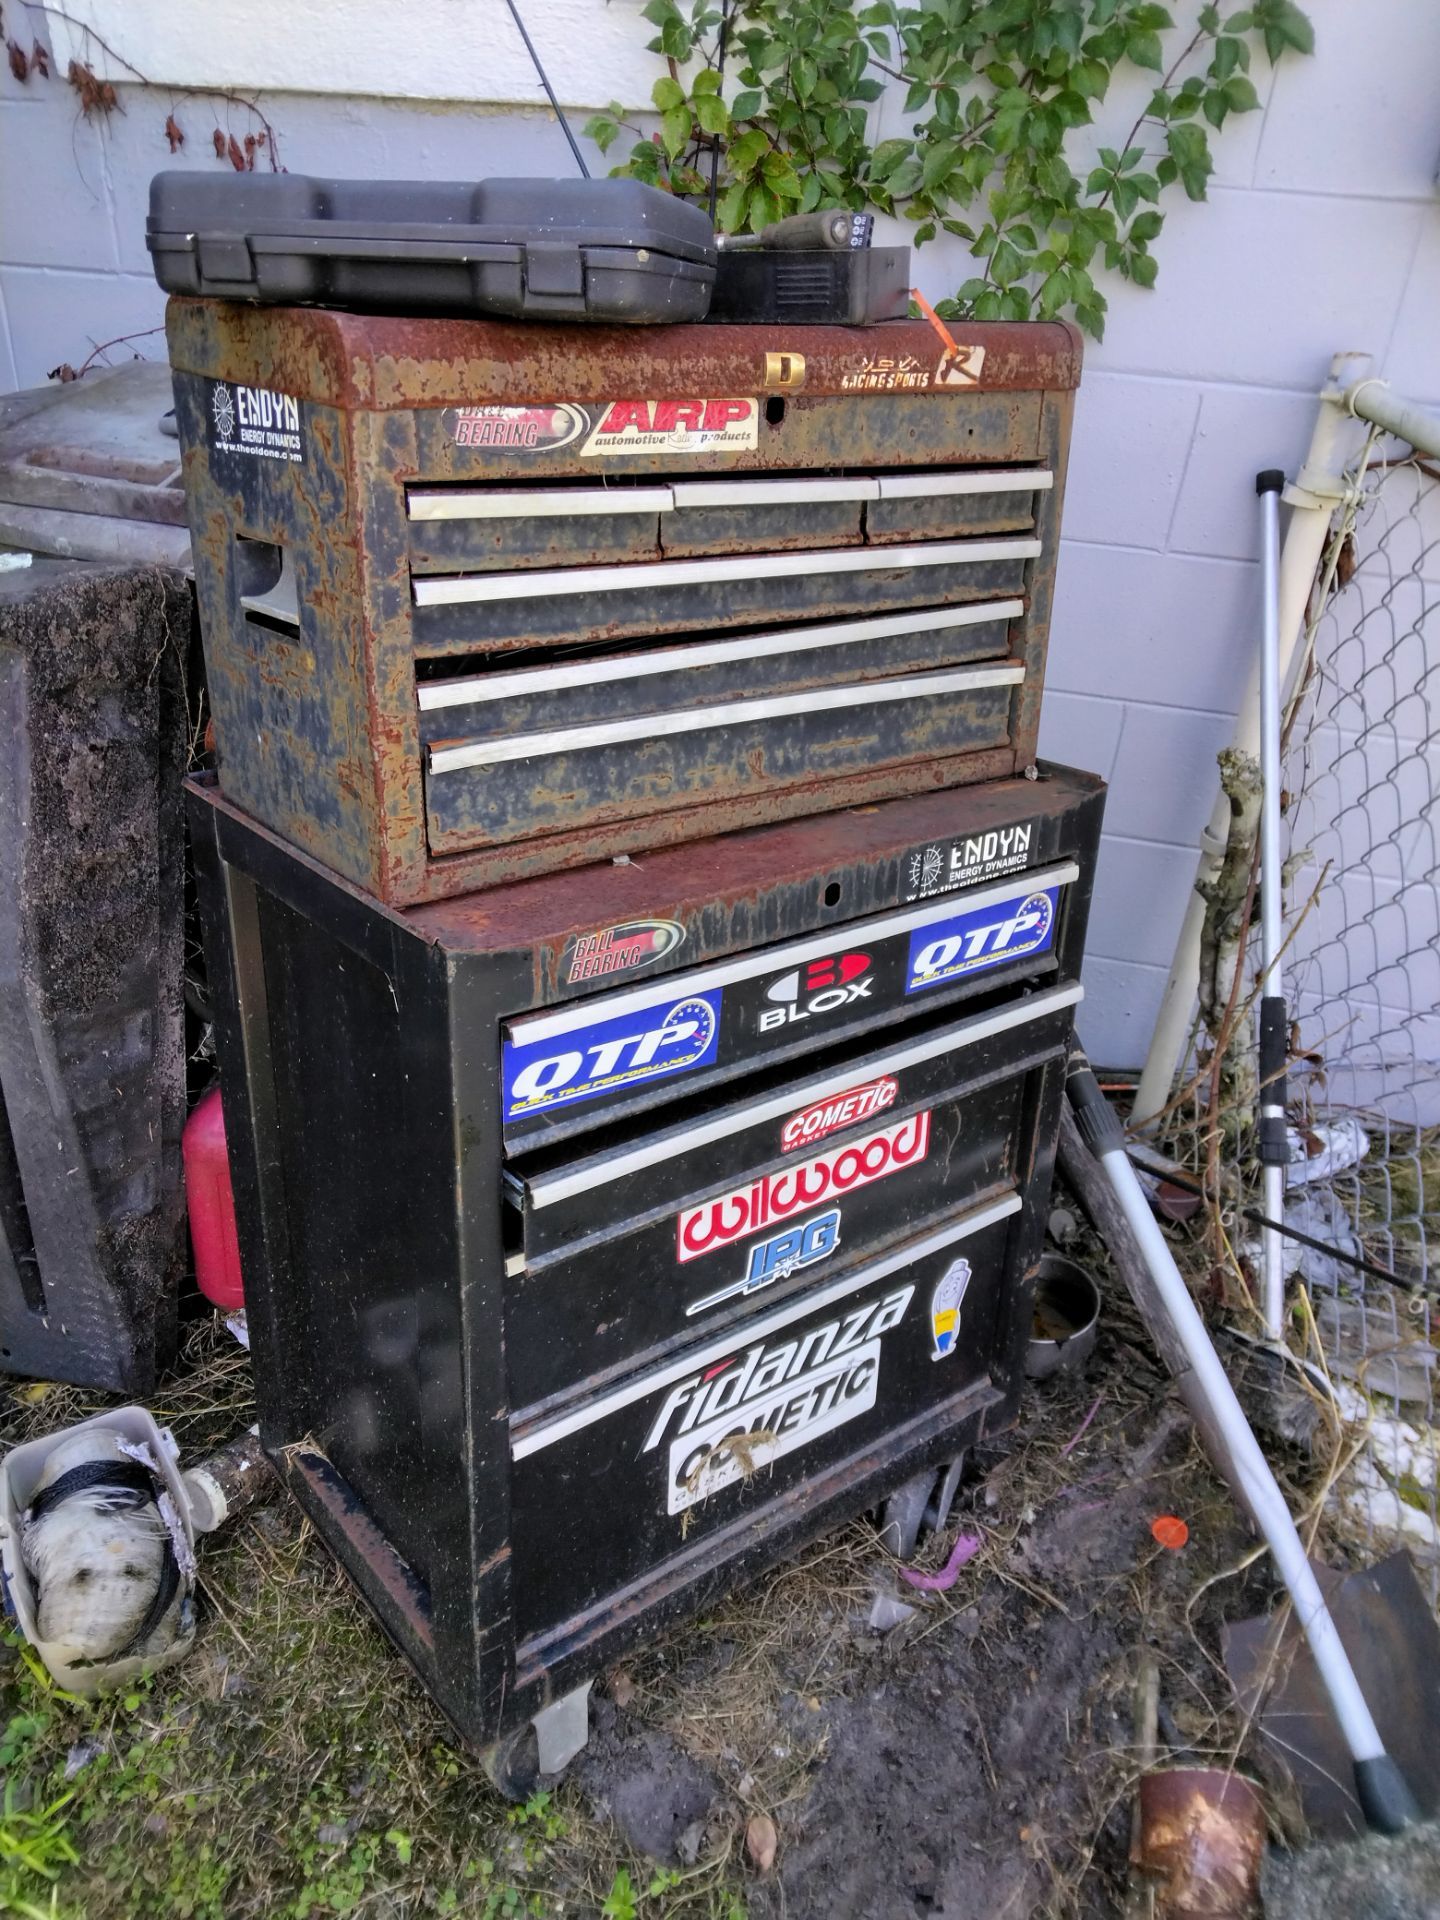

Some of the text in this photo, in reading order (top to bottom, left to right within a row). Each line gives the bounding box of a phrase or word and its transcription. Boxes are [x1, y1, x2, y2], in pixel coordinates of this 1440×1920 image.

[237, 386, 300, 432] ENDYN
[597, 399, 752, 434] ARP
[241, 428, 266, 445] ENERGY
[455, 419, 539, 448] BEARING
[595, 434, 666, 446] automotive
[949, 852, 1028, 882] ENERGY DYNAMICS
[950, 824, 1032, 870] ENDYN
[567, 945, 641, 984] BEARING
[573, 929, 615, 961] BALL
[914, 911, 1042, 976] QTP
[759, 977, 874, 1033] BLOX
[511, 1020, 699, 1101] QTP
[558, 1083, 591, 1098] TIME
[593, 1053, 697, 1088] PERFORMANCE
[784, 1081, 897, 1142] COMETIC
[783, 1129, 828, 1151] GASKET
[683, 1112, 923, 1252] wilwood
[642, 1285, 916, 1453] fidanza
